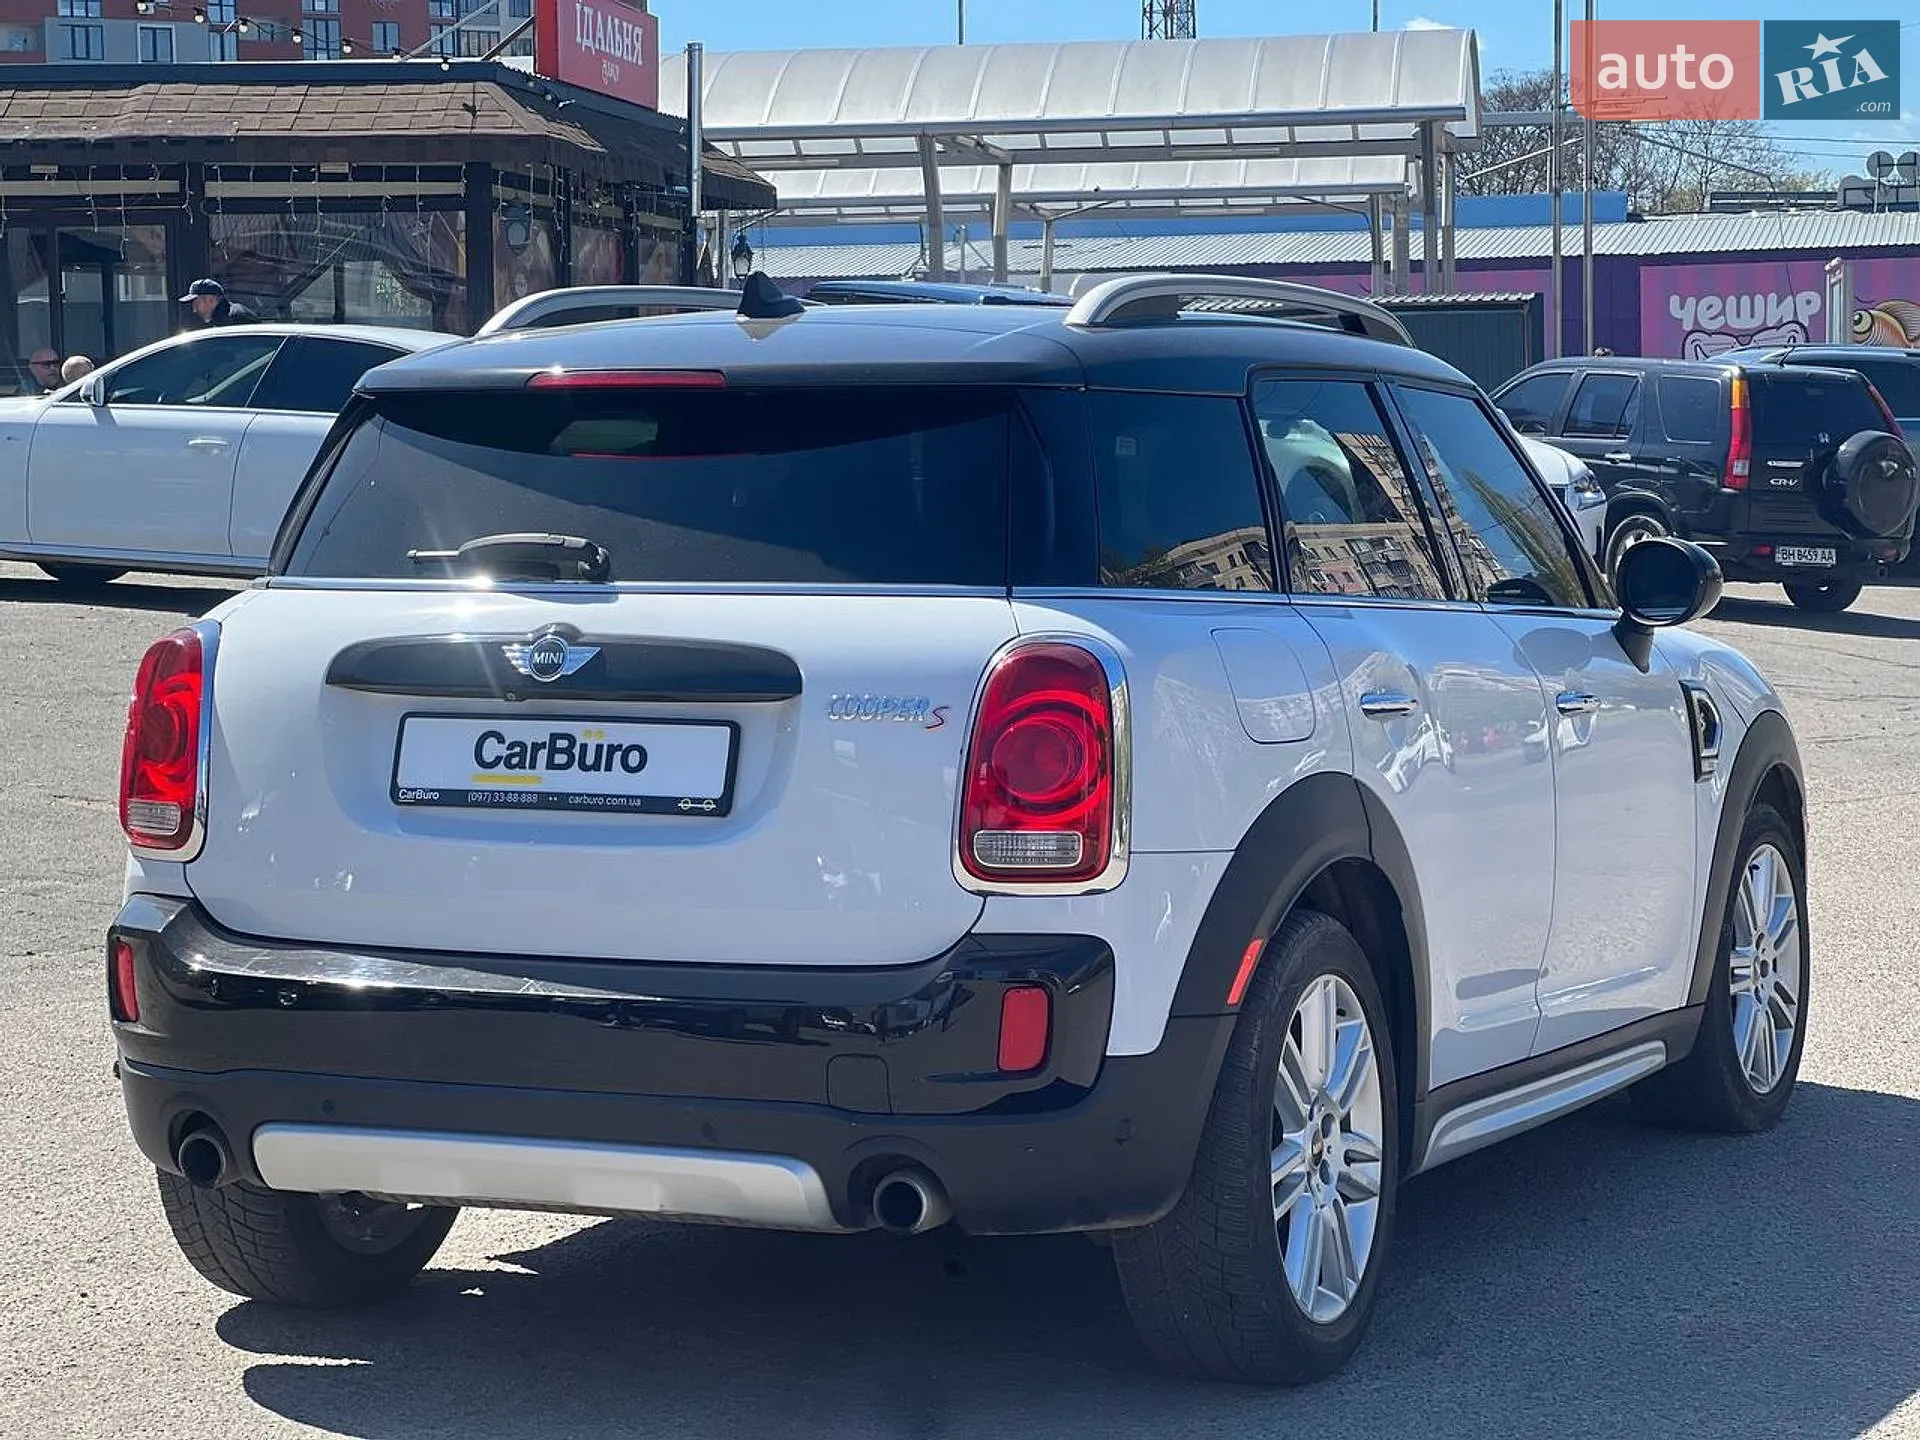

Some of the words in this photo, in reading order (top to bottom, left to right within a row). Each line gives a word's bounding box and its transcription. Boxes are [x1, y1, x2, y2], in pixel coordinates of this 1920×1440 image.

[1769, 478, 1798, 486] CR-V
[1781, 548, 1796, 561] BH
[1821, 550, 1834, 563] AA
[532, 651, 564, 664] MINI
[828, 694, 930, 721] COOPER
[925, 705, 950, 729] S
[474, 729, 648, 774] CarBüro
[467, 791, 492, 803] (097)
[493, 793, 538, 804] 33-88-888
